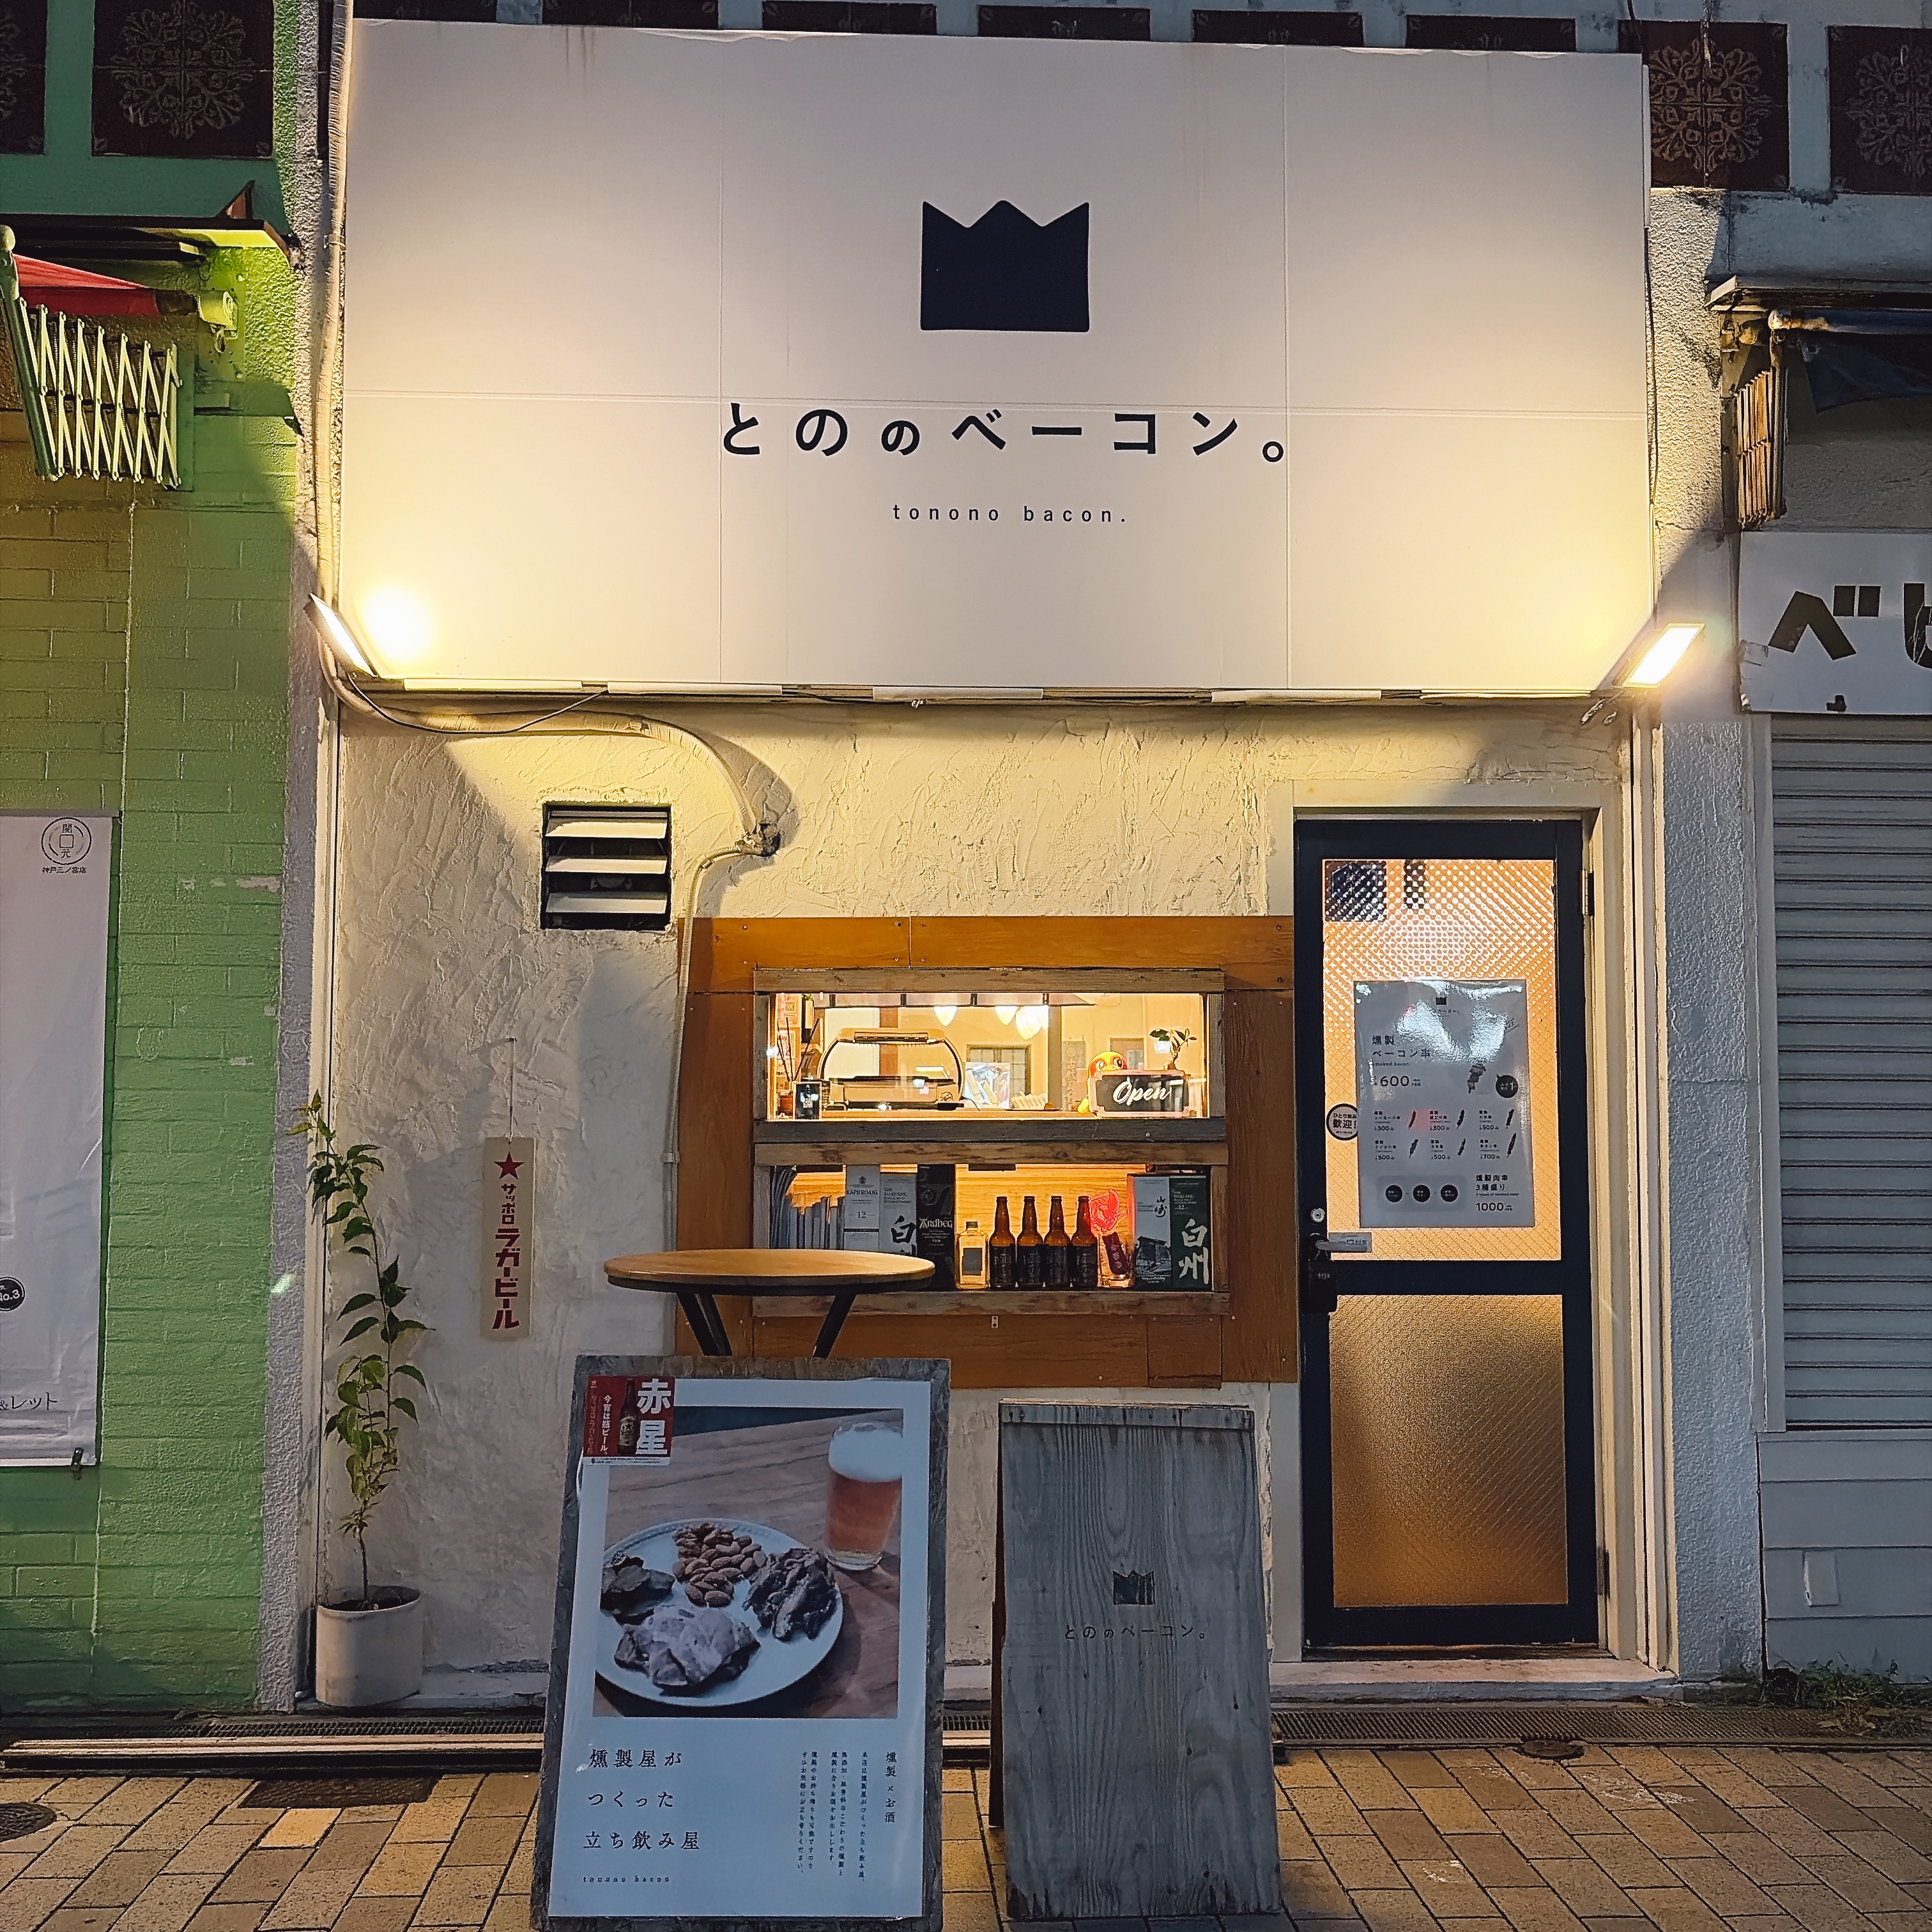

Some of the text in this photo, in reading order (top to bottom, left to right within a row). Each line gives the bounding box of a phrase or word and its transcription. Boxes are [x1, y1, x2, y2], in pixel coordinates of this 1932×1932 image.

[723, 402, 1284, 463] とののベーコン。
[893, 504, 1126, 523] tonono bacon.
[1380, 1075, 1409, 1086] 600
[1113, 1081, 1170, 1106] Open
[1476, 1202, 1504, 1211] 1000
[919, 1216, 953, 1229] Ardbeg
[1179, 1218, 1209, 1285] 白州
[637, 1378, 671, 1455] 赤星
[1065, 1625, 1205, 1639] とののベーコン。
[588, 1749, 682, 1768] 燻製屋が
[588, 1791, 673, 1808] つくった
[583, 1830, 700, 1850] 立ち飲み屋
